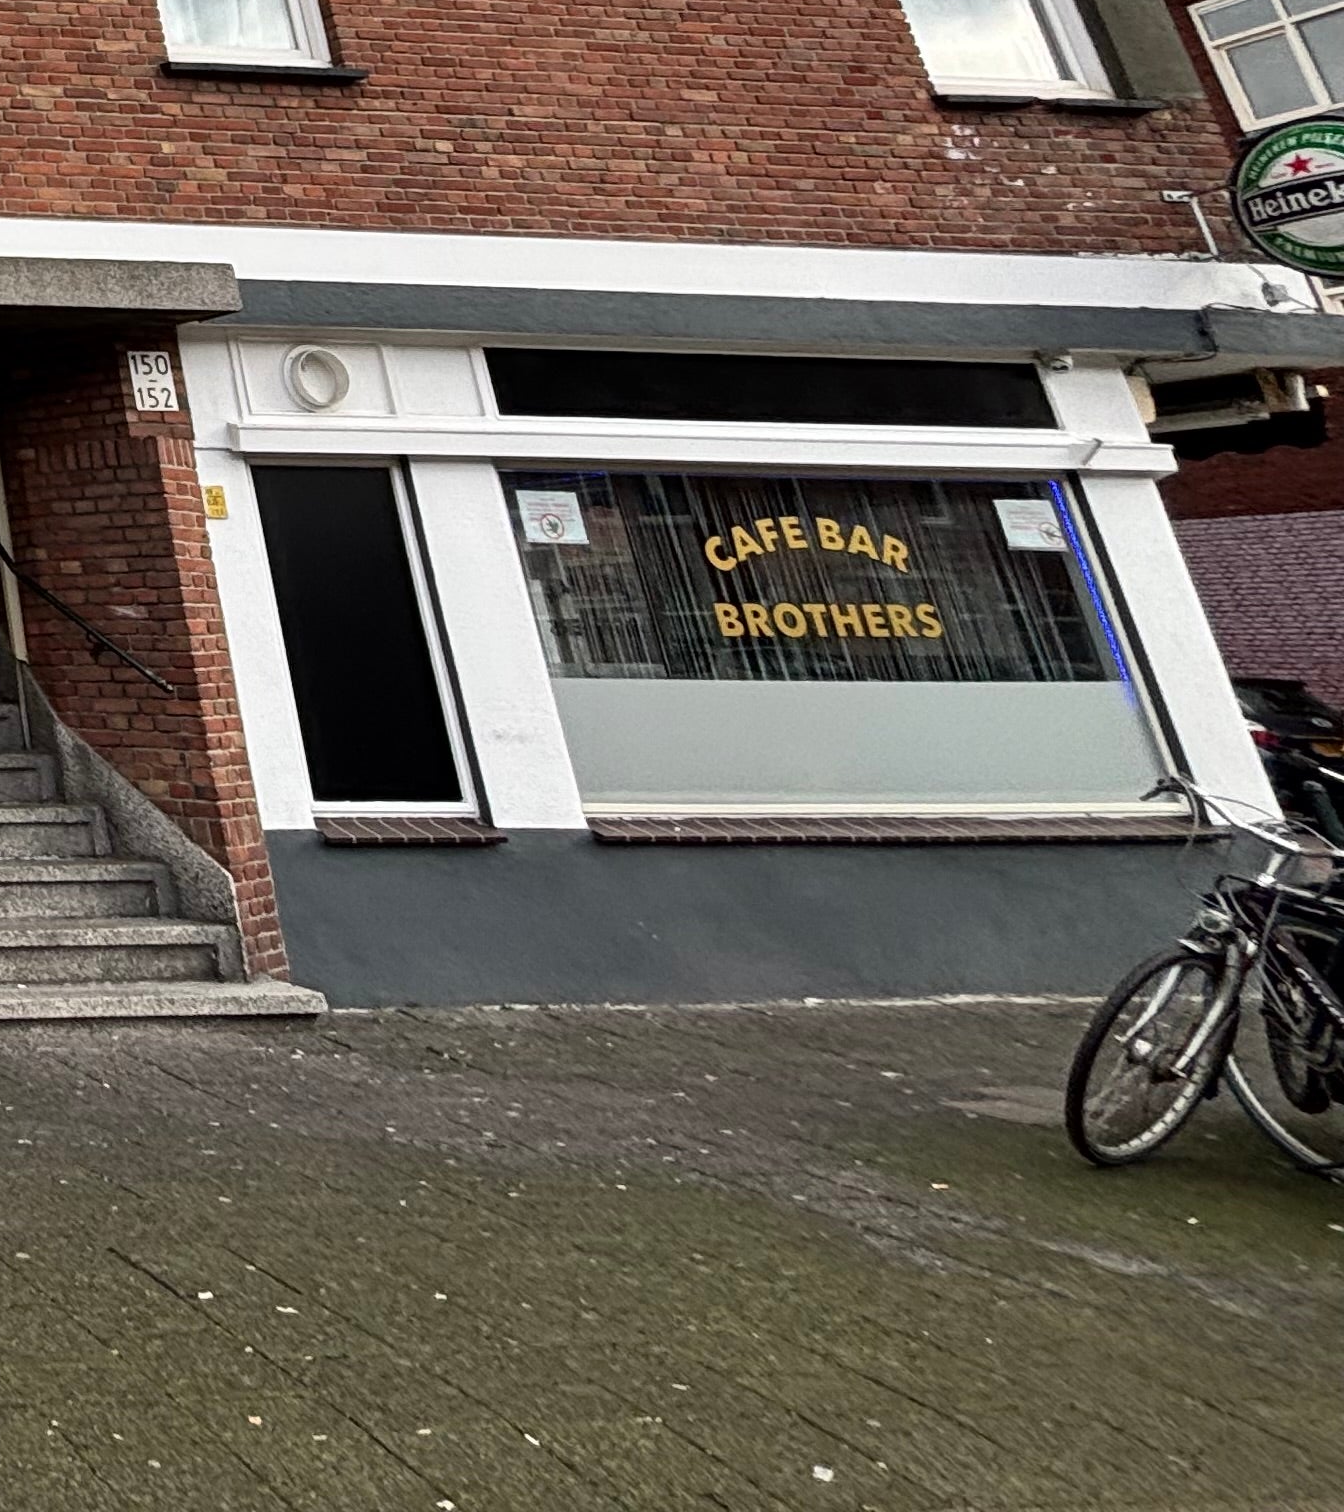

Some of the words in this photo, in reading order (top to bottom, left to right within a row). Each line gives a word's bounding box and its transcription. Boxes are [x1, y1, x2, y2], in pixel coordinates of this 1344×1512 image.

[130, 354, 169, 376] 150
[137, 387, 174, 408] 152
[704, 515, 809, 571] CAFE
[815, 516, 909, 574] BAR
[713, 601, 943, 638] BROTHERS
